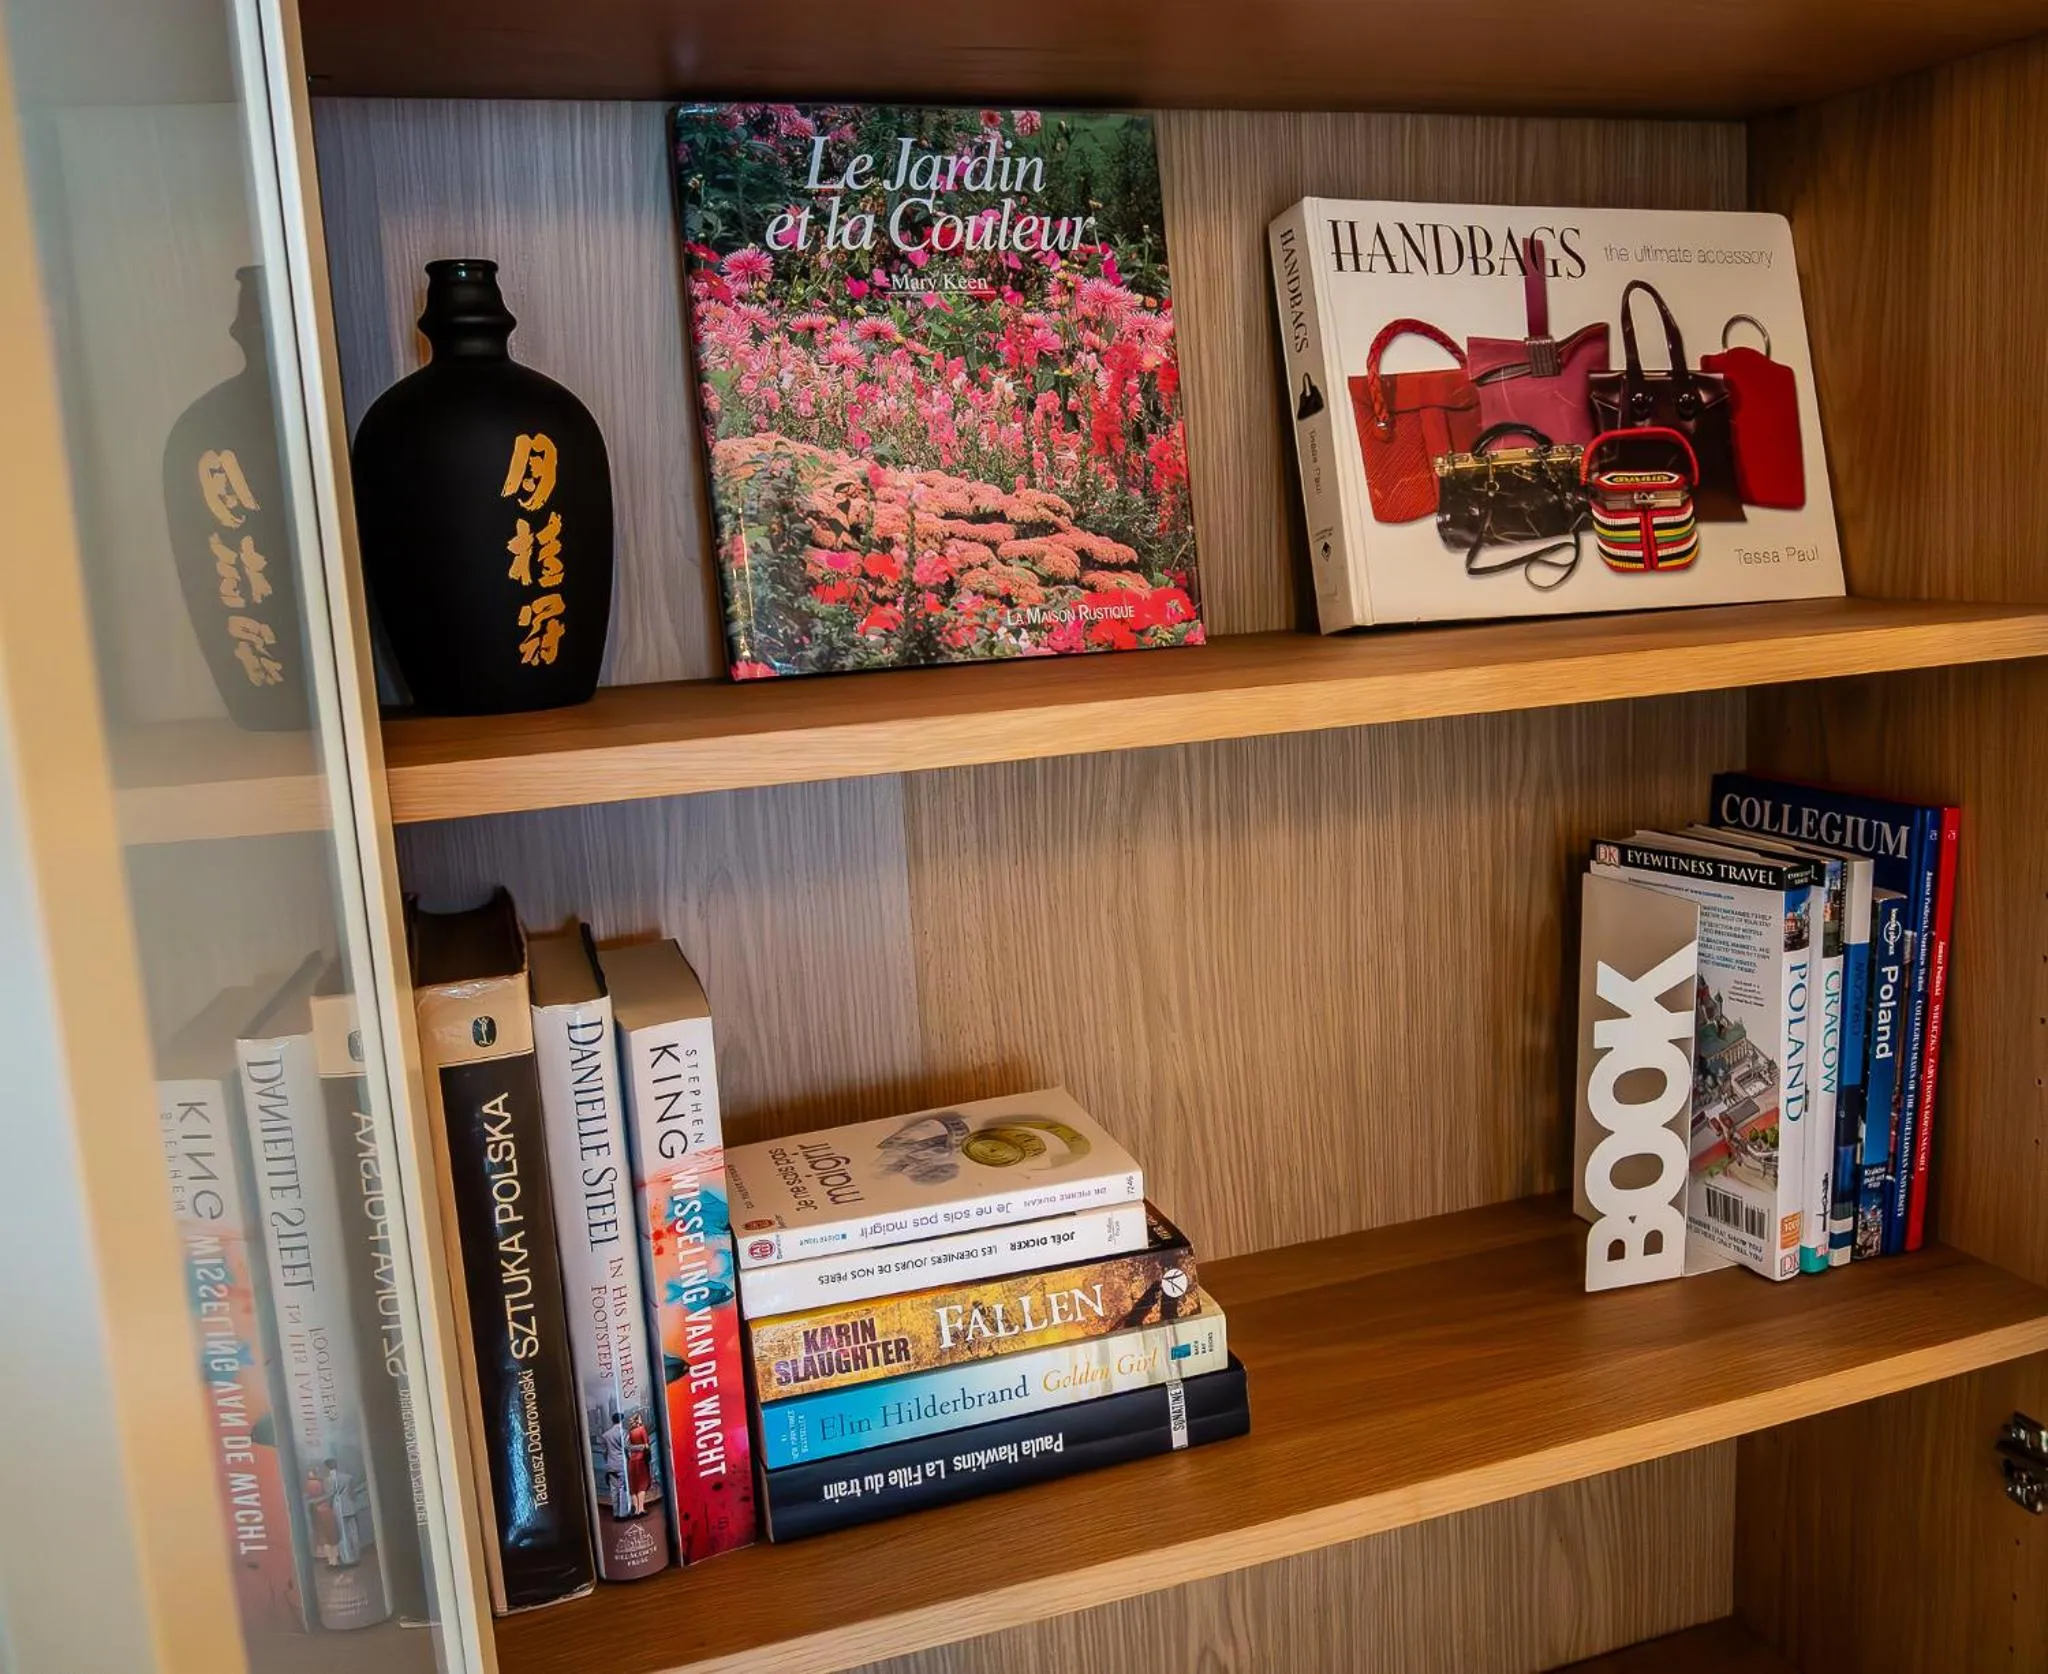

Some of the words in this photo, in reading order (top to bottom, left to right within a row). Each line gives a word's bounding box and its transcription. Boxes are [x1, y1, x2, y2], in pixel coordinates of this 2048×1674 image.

[804, 135, 874, 190] Le
[883, 137, 1047, 192] Jardin
[765, 206, 815, 251] et
[826, 196, 877, 251] la
[889, 197, 1096, 252] Couleur
[1327, 219, 1587, 280] HANDBAGS
[1603, 243, 1630, 262] the
[1634, 244, 1693, 264] ultimate
[1697, 248, 1774, 270] accessory
[891, 274, 940, 297] Mary
[943, 273, 989, 291] Keen
[1279, 227, 1309, 354] HANDBAGS
[1734, 547, 1781, 566] Tessa
[1785, 546, 1819, 563] Paul
[1721, 793, 1910, 860] COLLEGIUM
[1597, 844, 1621, 866] DK
[1626, 849, 1714, 876] EYEWITNESS
[1717, 862, 1777, 886] TRAVEL
[1875, 965, 1900, 1060] Poland
[1785, 961, 1808, 1122] POLAND
[1821, 970, 1842, 1095] CRACOW
[566, 1016, 612, 1162] DANIELLE
[649, 1043, 689, 1160] KING
[685, 1049, 706, 1145] STEPHEN
[1584, 940, 1698, 1292] BOOK
[481, 1091, 525, 1227] POLSKA
[768, 1147, 795, 1166] pas
[777, 1165, 802, 1186] sais
[797, 1142, 866, 1206] maigrir
[789, 1186, 811, 1199] ne
[795, 1199, 819, 1212] Je
[996, 1201, 1014, 1215] Je
[582, 1167, 620, 1253] STEEL
[912, 1211, 938, 1228] pas
[943, 1208, 971, 1224] sais
[974, 1205, 993, 1217] ne
[671, 1166, 711, 1305] WISSELING
[860, 1219, 909, 1240] maigrir
[1009, 1234, 1050, 1252] DICKER
[1050, 1230, 1076, 1247] JOËL
[894, 1257, 928, 1272] JOURS
[930, 1248, 979, 1266] DERNIERS
[981, 1243, 998, 1256] LES
[608, 1256, 624, 1280] IN
[850, 1268, 875, 1281] NOS
[877, 1264, 892, 1274] DE
[497, 1230, 540, 1360] SZTUKA
[612, 1284, 629, 1318] HIS
[590, 1284, 614, 1380] FOOTSTEPS
[684, 1306, 719, 1358] VAN
[935, 1283, 1105, 1350] FALLEN
[802, 1316, 878, 1356] KARIN
[616, 1322, 638, 1399] FATHER'S
[689, 1360, 719, 1394] DE
[774, 1336, 912, 1387] SLAUGHTER
[517, 1368, 543, 1453] Dobrowolski
[820, 1412, 872, 1441] Elin
[879, 1373, 1030, 1429] Hilderbrand
[1042, 1364, 1110, 1393] Golden
[1117, 1346, 1159, 1376] Girl
[692, 1395, 727, 1480] WACHT
[1021, 1432, 1065, 1460] Paula
[888, 1464, 922, 1489] Fille
[925, 1459, 946, 1480] La
[953, 1446, 1019, 1473] Hawkins
[532, 1452, 549, 1510] Tadeusz
[822, 1484, 862, 1503] train
[865, 1478, 885, 1495] du
